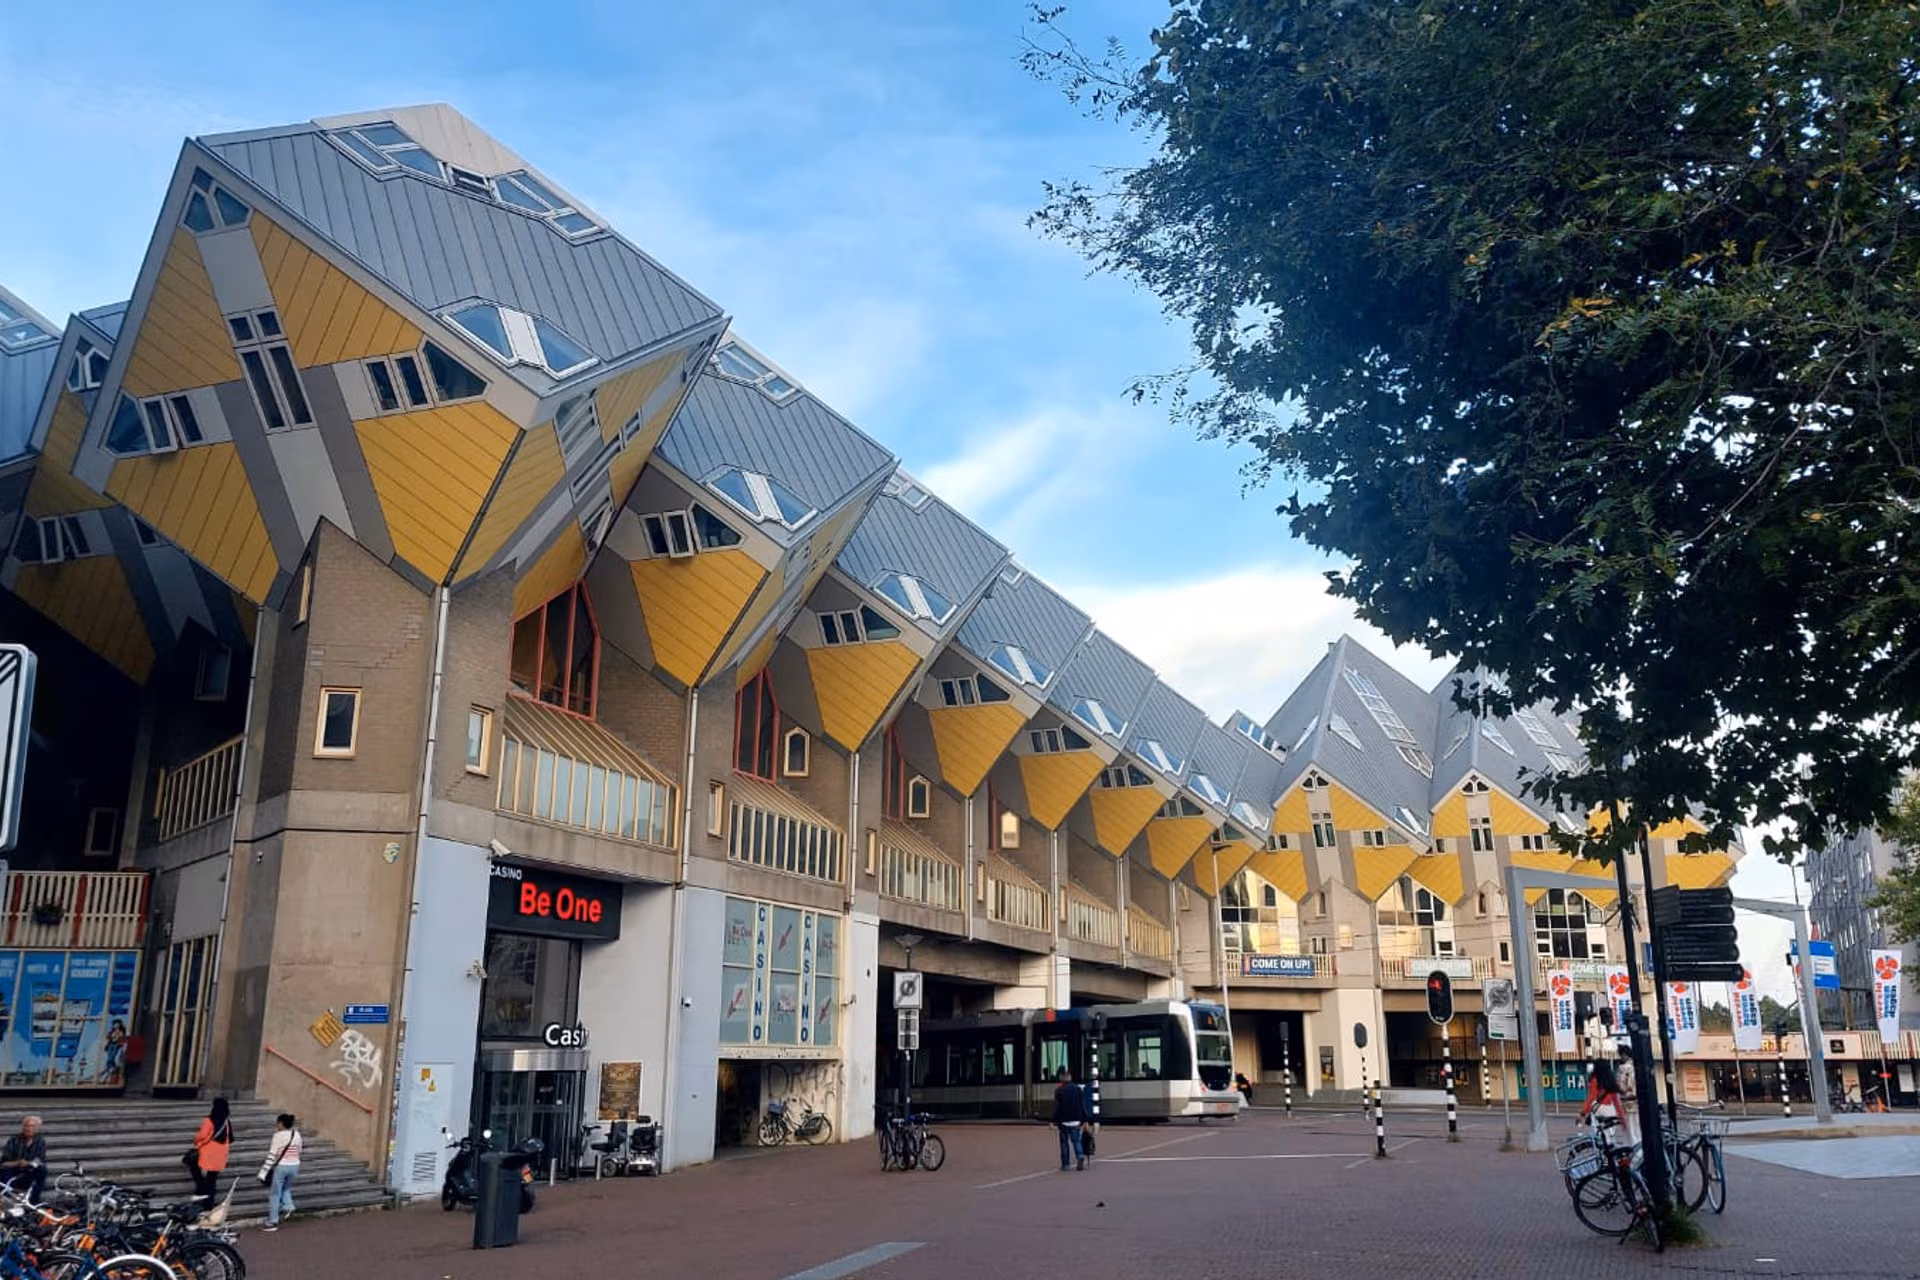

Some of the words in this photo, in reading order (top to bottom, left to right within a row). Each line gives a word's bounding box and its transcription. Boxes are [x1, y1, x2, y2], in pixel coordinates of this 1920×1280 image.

[490, 864, 522, 880] CASINO
[520, 882, 551, 917] Be
[556, 887, 602, 923] One
[753, 906, 766, 1040] CASINO
[801, 915, 811, 1042] CASINO
[1251, 958, 1279, 969] COME
[1280, 959, 1293, 969] ON
[1294, 959, 1311, 969] UP!
